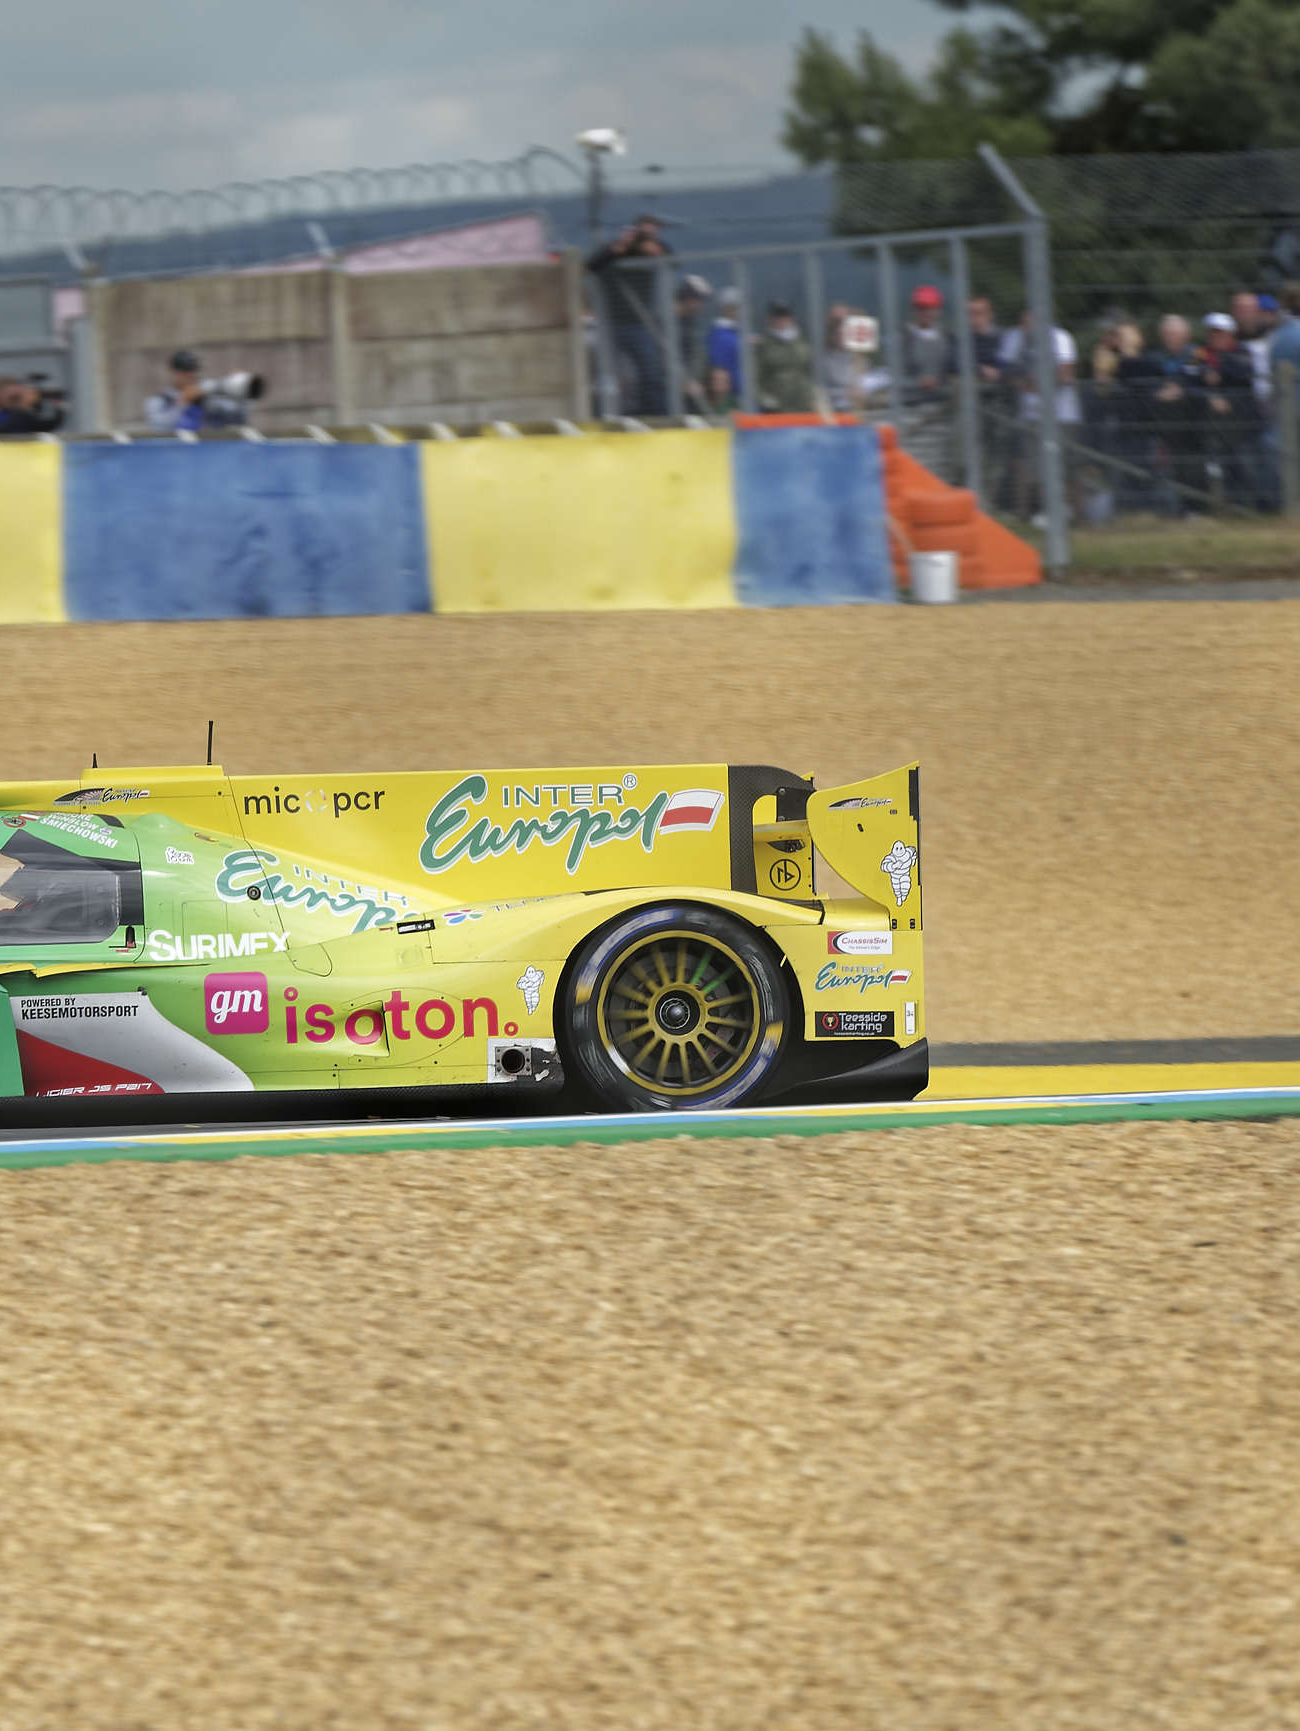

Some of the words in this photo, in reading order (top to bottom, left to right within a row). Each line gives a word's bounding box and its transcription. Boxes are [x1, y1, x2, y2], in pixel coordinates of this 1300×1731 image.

[418, 773, 670, 875] Europol
[814, 961, 893, 994] Europol
[20, 998, 62, 1008] POWERED
[64, 997, 76, 1006] BY
[210, 989, 264, 1024] gm
[21, 1005, 139, 1020] KEESEMOTORSPORT
[838, 1012, 888, 1022] Teesside
[841, 1021, 883, 1033] karting
